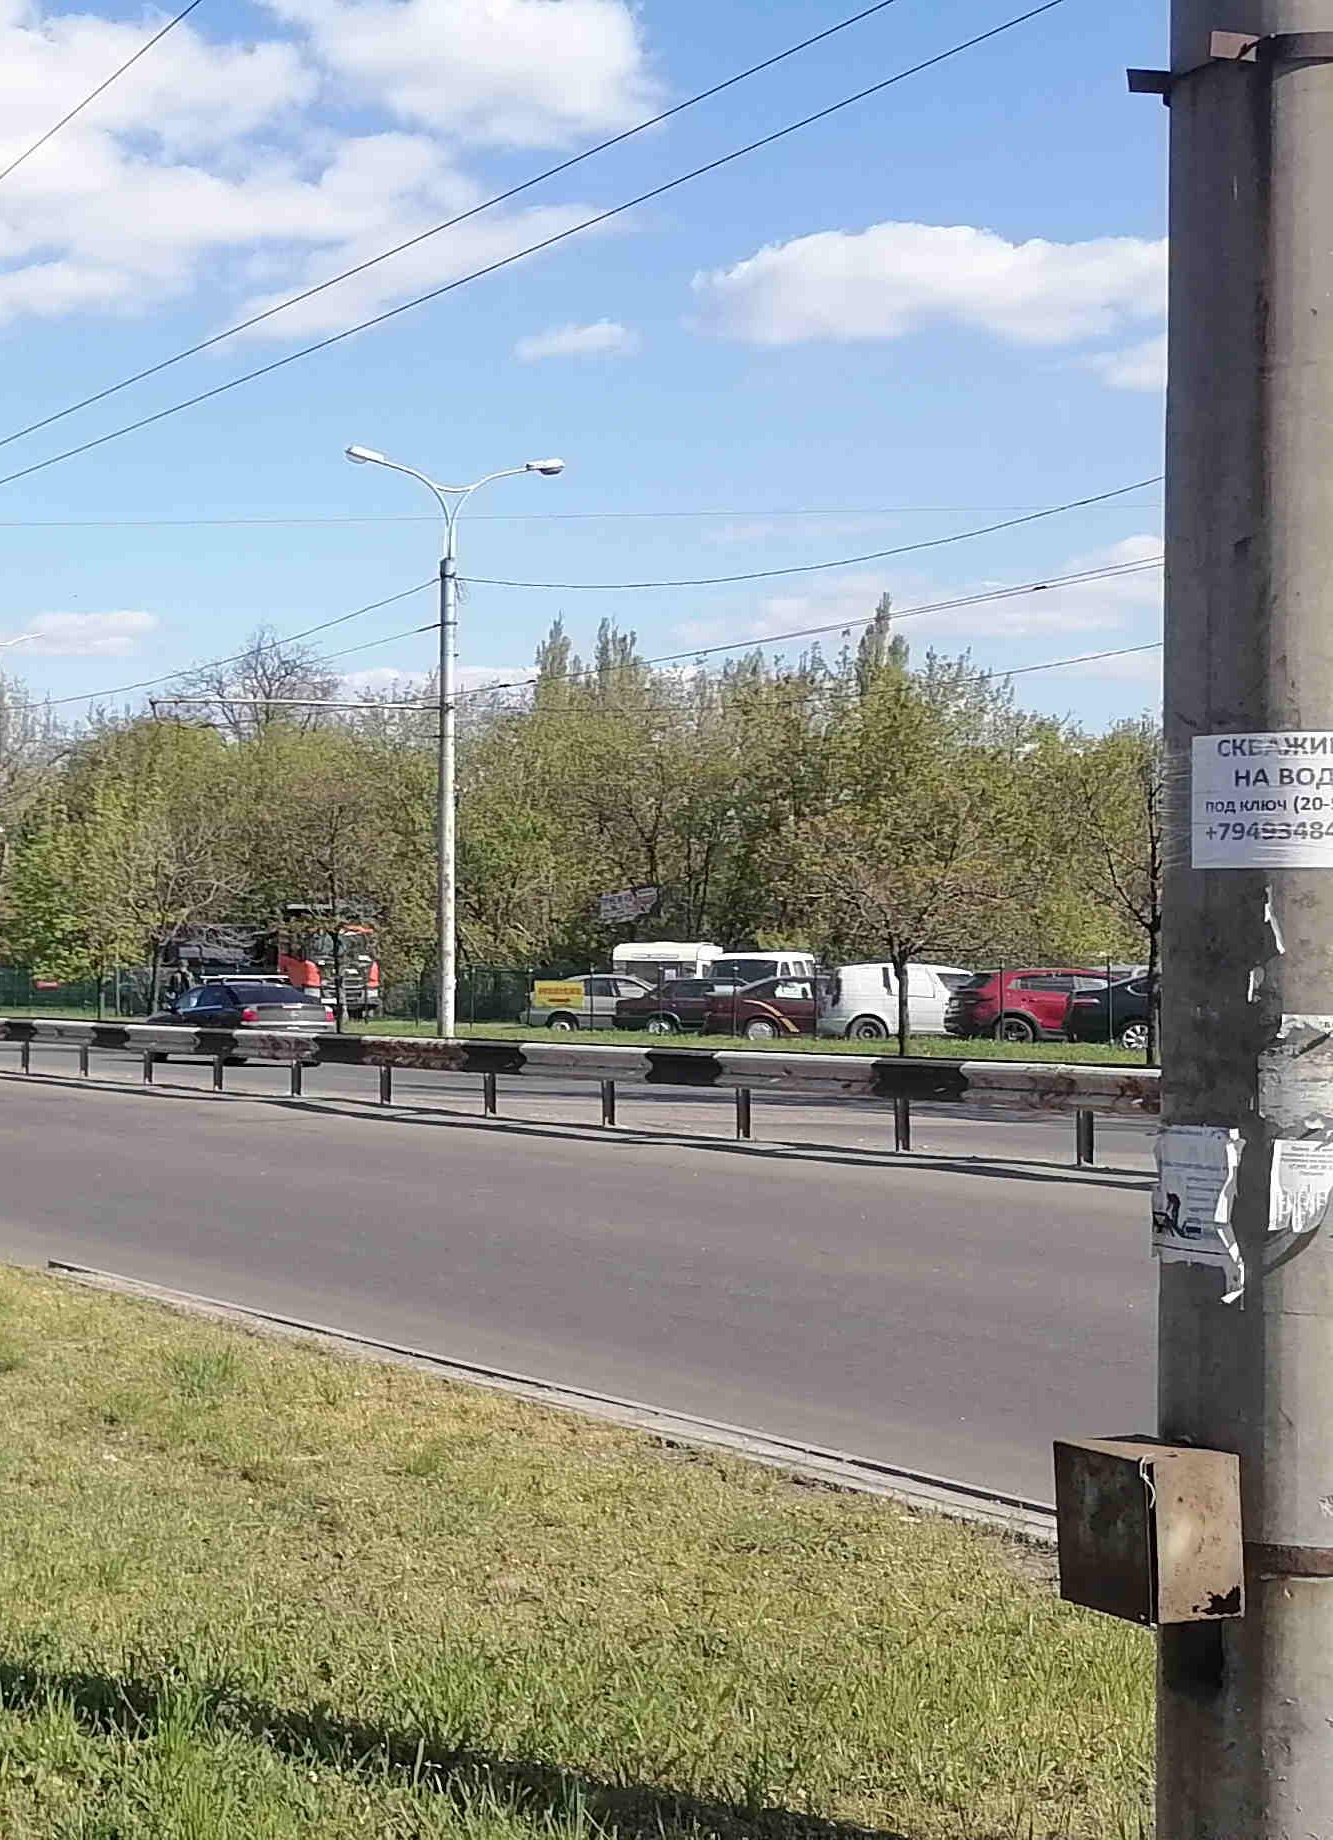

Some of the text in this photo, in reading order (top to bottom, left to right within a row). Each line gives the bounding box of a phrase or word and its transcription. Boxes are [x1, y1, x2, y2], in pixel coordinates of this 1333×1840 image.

[1234, 768, 1269, 787] НА
[1206, 800, 1236, 815] под
[1293, 795, 1333, 815] (20-
